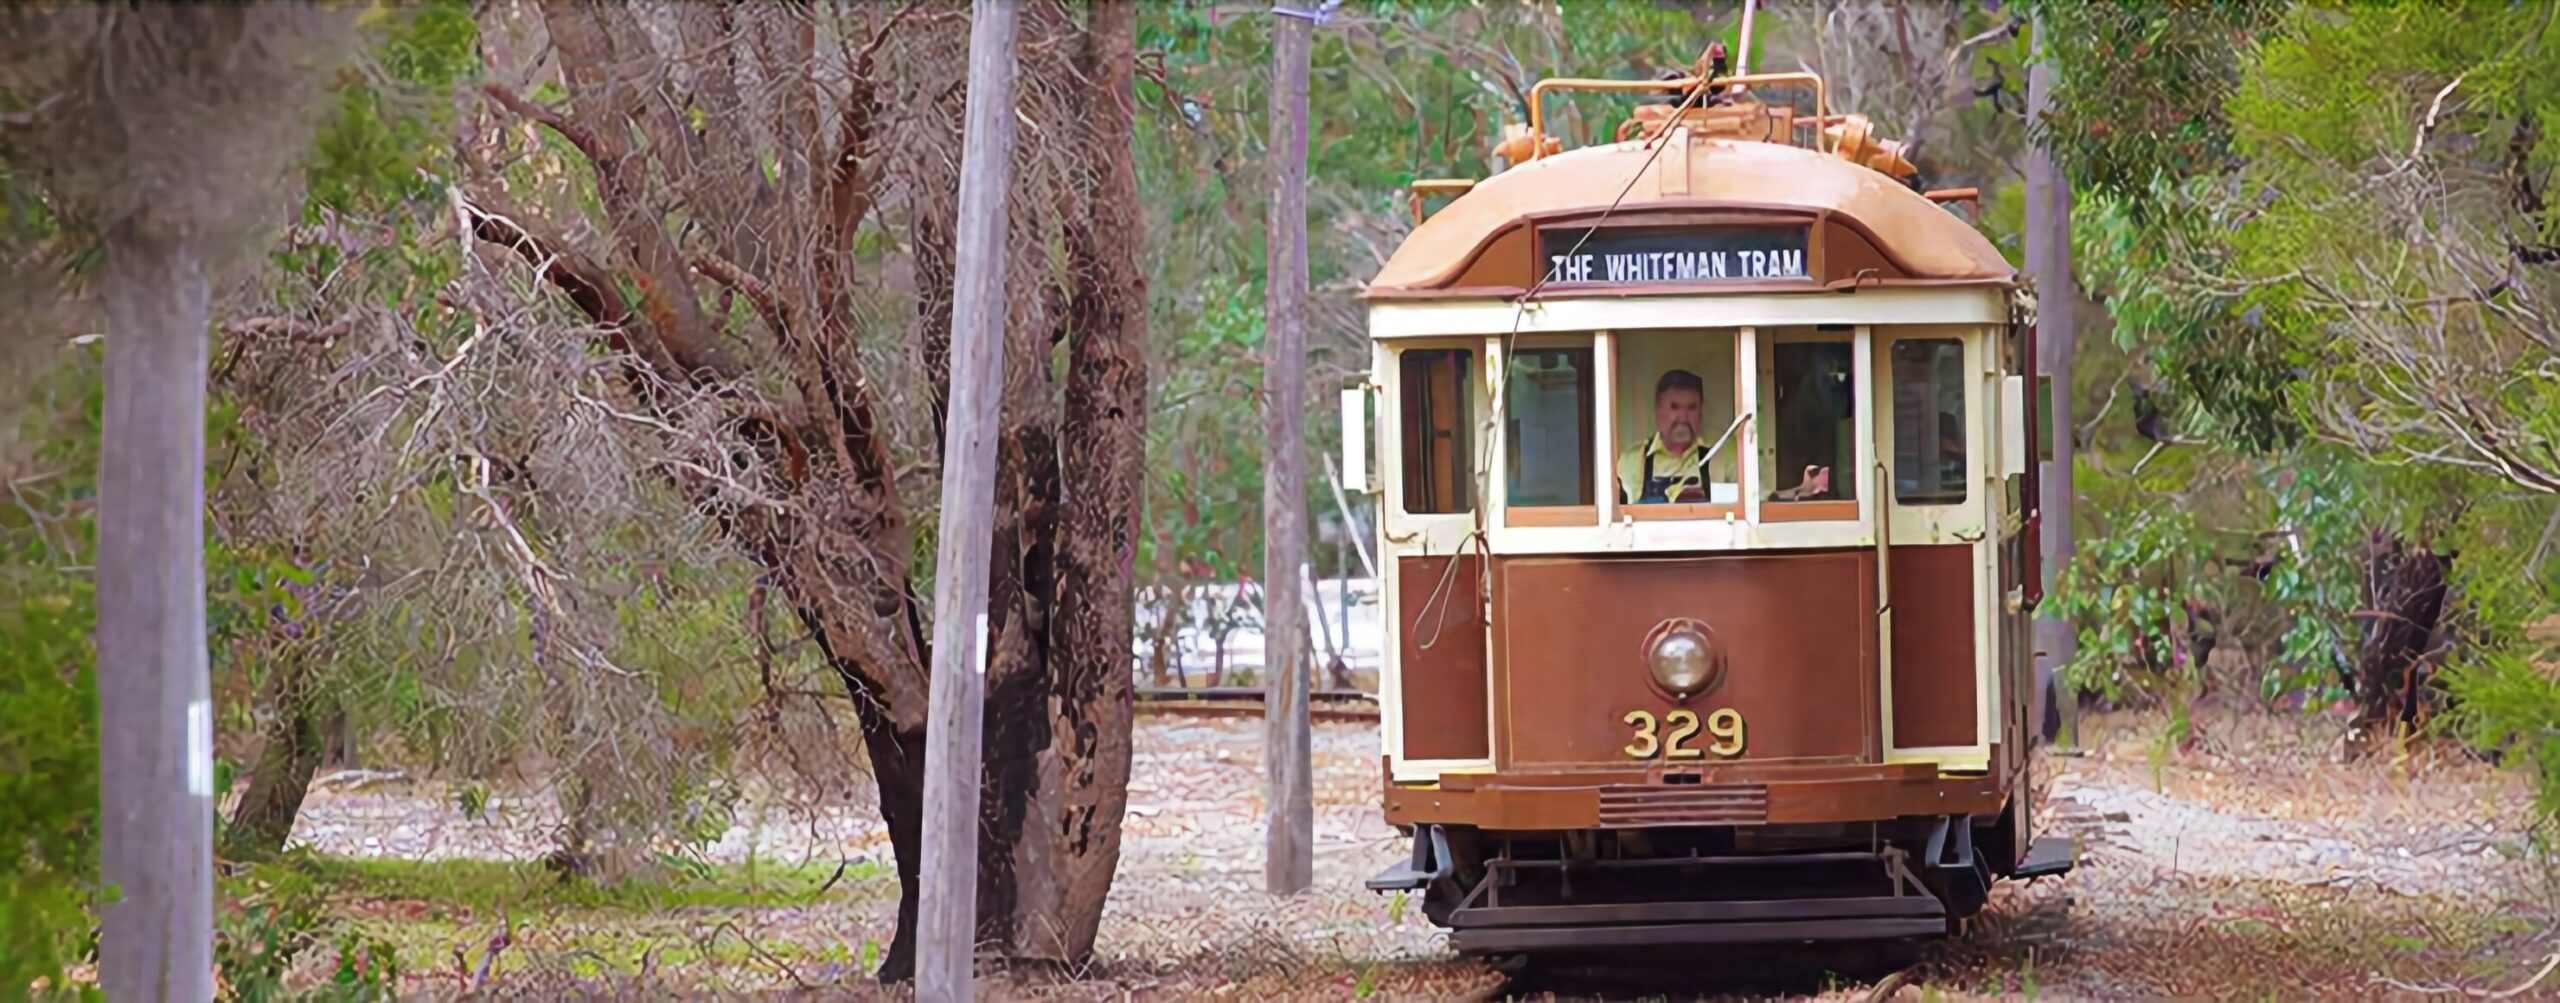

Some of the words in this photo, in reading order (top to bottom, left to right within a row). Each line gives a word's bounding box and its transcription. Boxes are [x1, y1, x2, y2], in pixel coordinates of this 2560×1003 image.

[1551, 254, 1593, 283] THE
[1605, 251, 1726, 281] WHITEMAN
[1737, 249, 1801, 278] TRAM
[1623, 708, 1747, 760] 329
